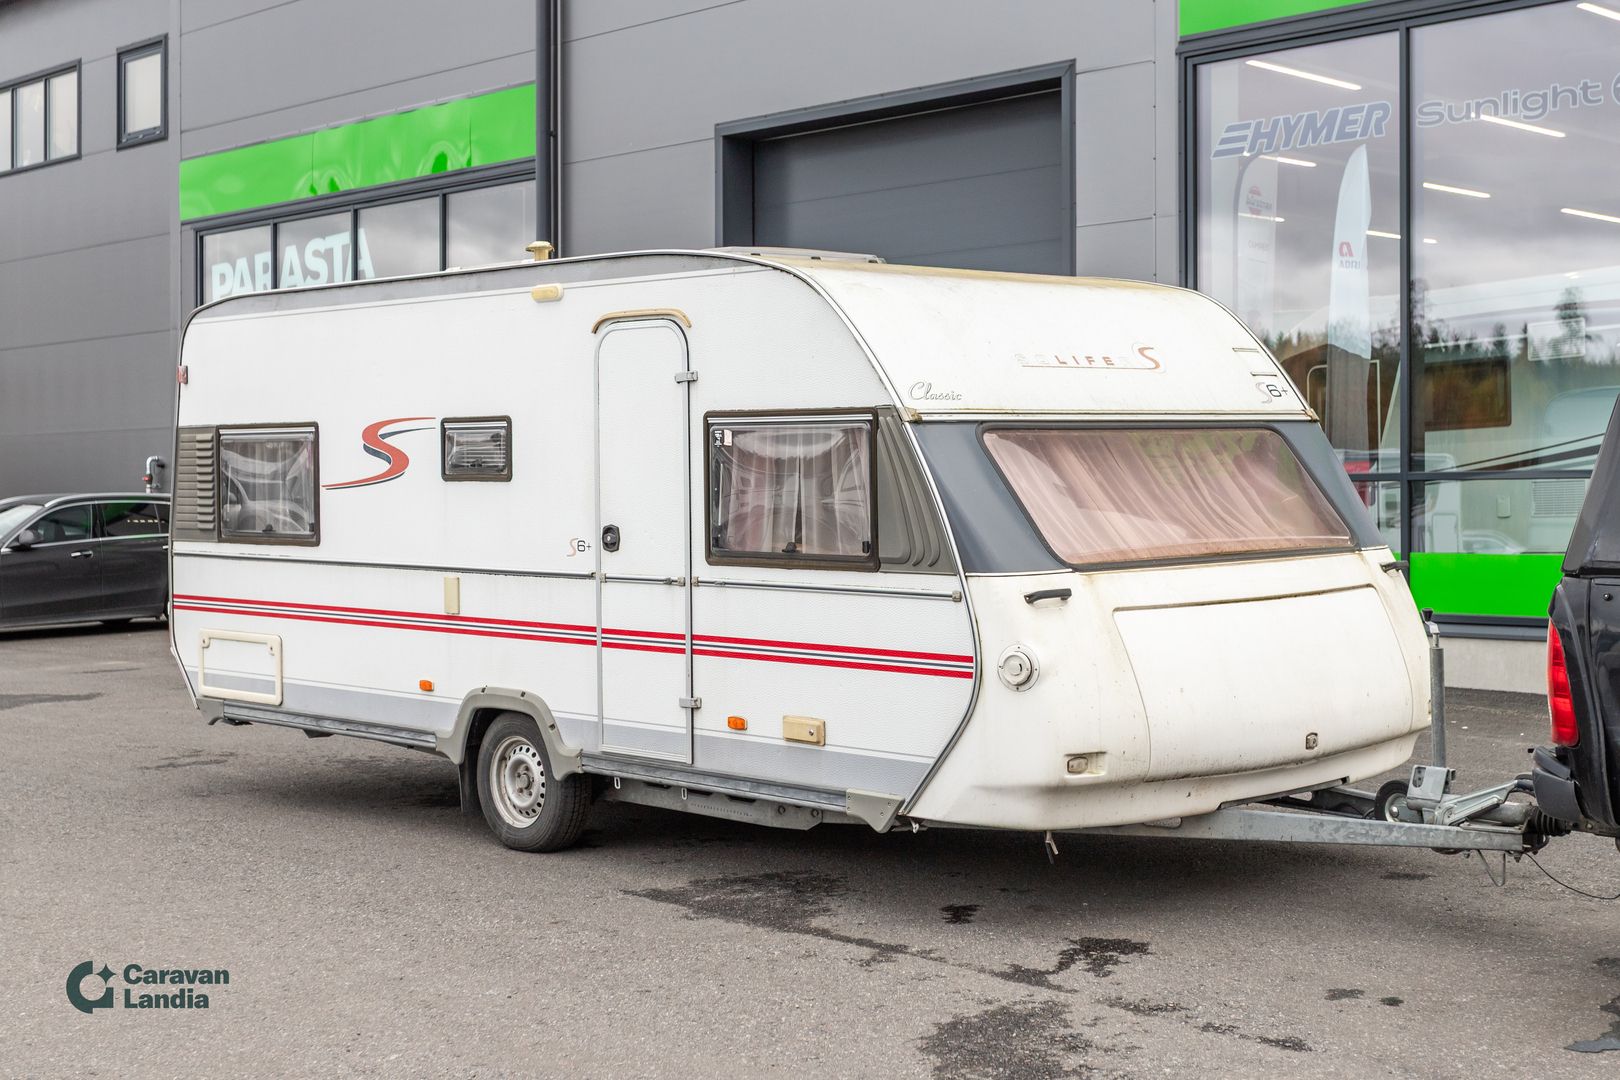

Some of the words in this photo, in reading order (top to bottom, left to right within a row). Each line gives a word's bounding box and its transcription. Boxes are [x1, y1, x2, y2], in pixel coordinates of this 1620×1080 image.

[1246, 101, 1392, 157] HYMER
[1416, 79, 1604, 128] Sunlight
[211, 228, 376, 300] PARASTA
[909, 381, 963, 401] Classic
